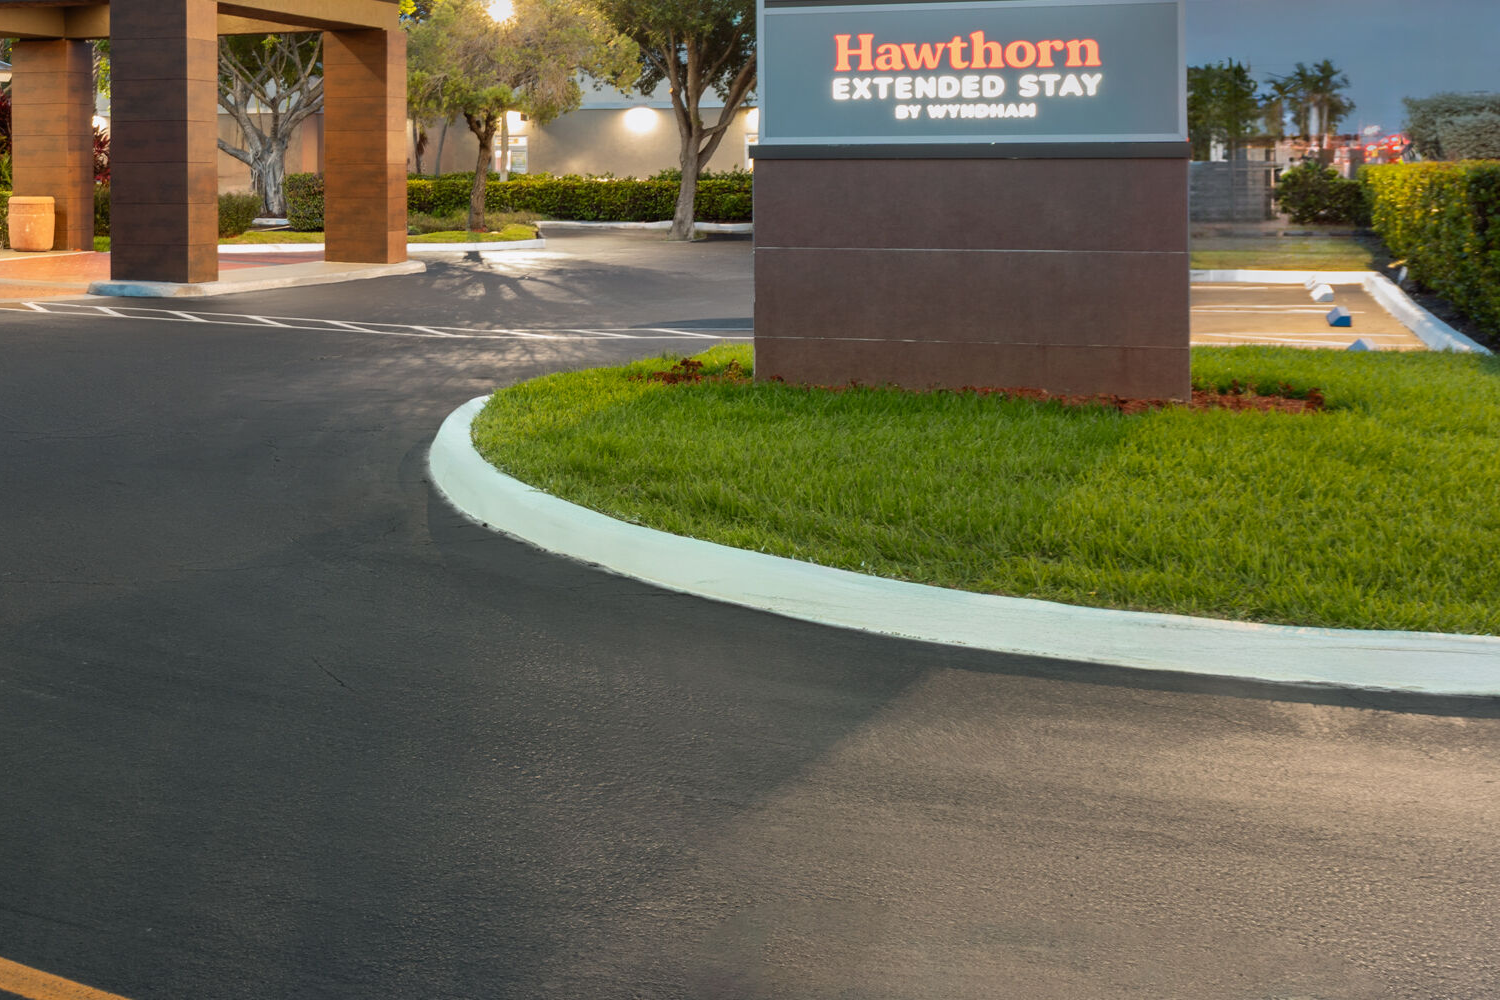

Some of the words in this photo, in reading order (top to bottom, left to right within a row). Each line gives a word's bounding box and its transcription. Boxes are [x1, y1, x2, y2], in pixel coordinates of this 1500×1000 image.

[834, 30, 1102, 71] Hawthorn
[831, 75, 1006, 100] EXTENDED
[1018, 73, 1103, 98] STAY
[895, 104, 922, 119] BY
[926, 102, 1037, 119] WYNDHAM
